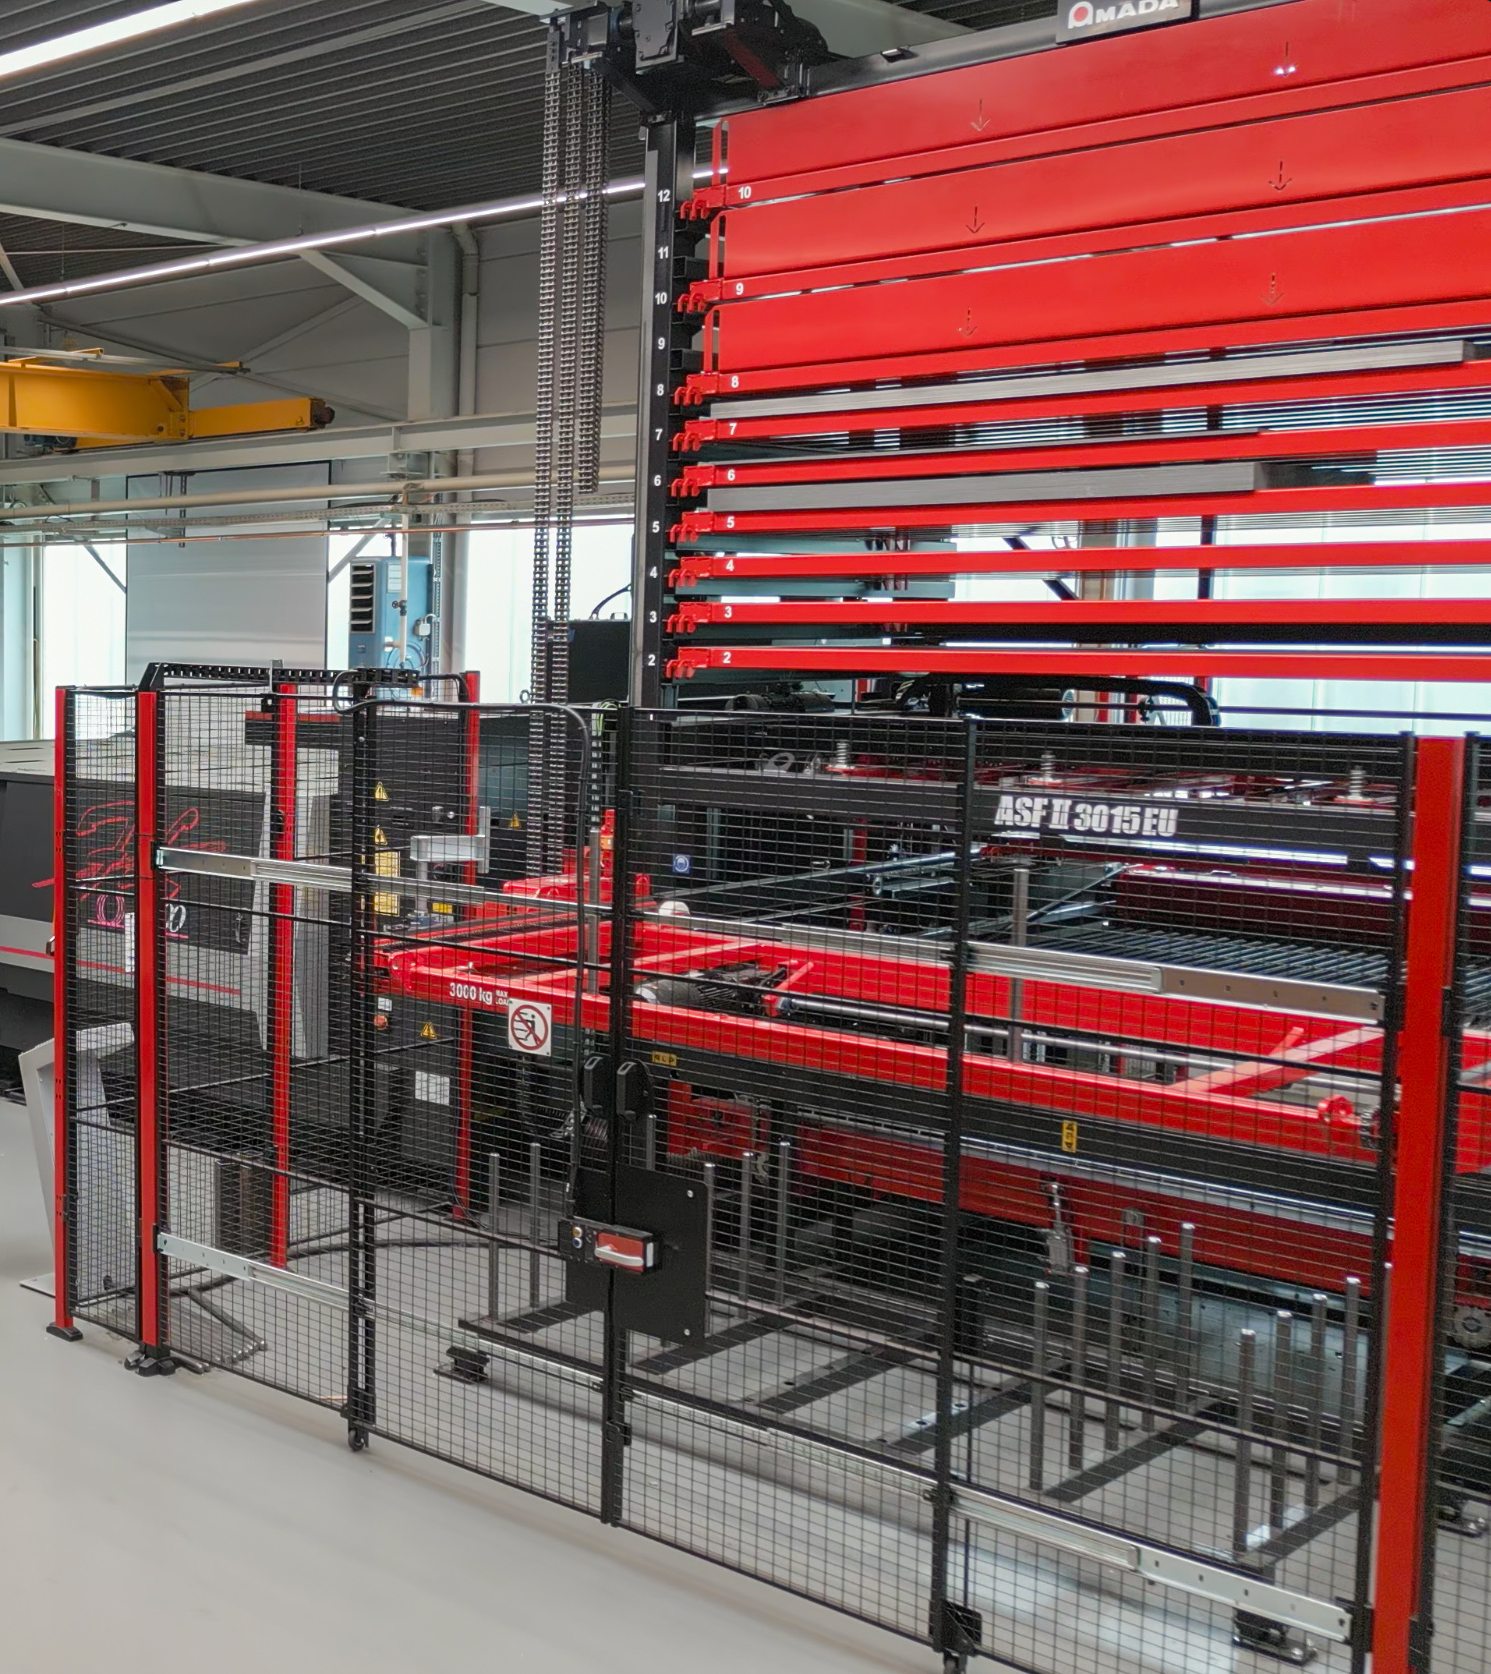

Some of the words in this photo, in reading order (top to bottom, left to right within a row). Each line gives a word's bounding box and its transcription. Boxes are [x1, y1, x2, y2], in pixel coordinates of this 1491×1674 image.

[1067, 0, 1179, 29] AMADA
[657, 189, 671, 203] 12
[738, 186, 752, 200] 10
[657, 246, 669, 259] 11
[735, 282, 744, 296] 9
[655, 292, 668, 305] 10
[657, 337, 666, 350] 9
[731, 375, 739, 388] 8
[656, 383, 664, 396] 8
[655, 428, 663, 441] 7
[729, 422, 737, 436] 7
[653, 474, 662, 487] 6
[727, 469, 735, 481] 6
[652, 521, 660, 533] 5
[726, 516, 735, 529] 5
[725, 559, 735, 572] 4
[649, 566, 658, 579] 4
[649, 610, 657, 623] 3
[724, 606, 732, 618] 3
[647, 653, 656, 666] 2
[722, 651, 732, 664] 2
[994, 795, 1048, 828] ASF
[1074, 803, 1141, 834] 3015
[1142, 807, 1179, 837] EU
[449, 982, 477, 1001] 3000
[479, 987, 493, 1006] kg
